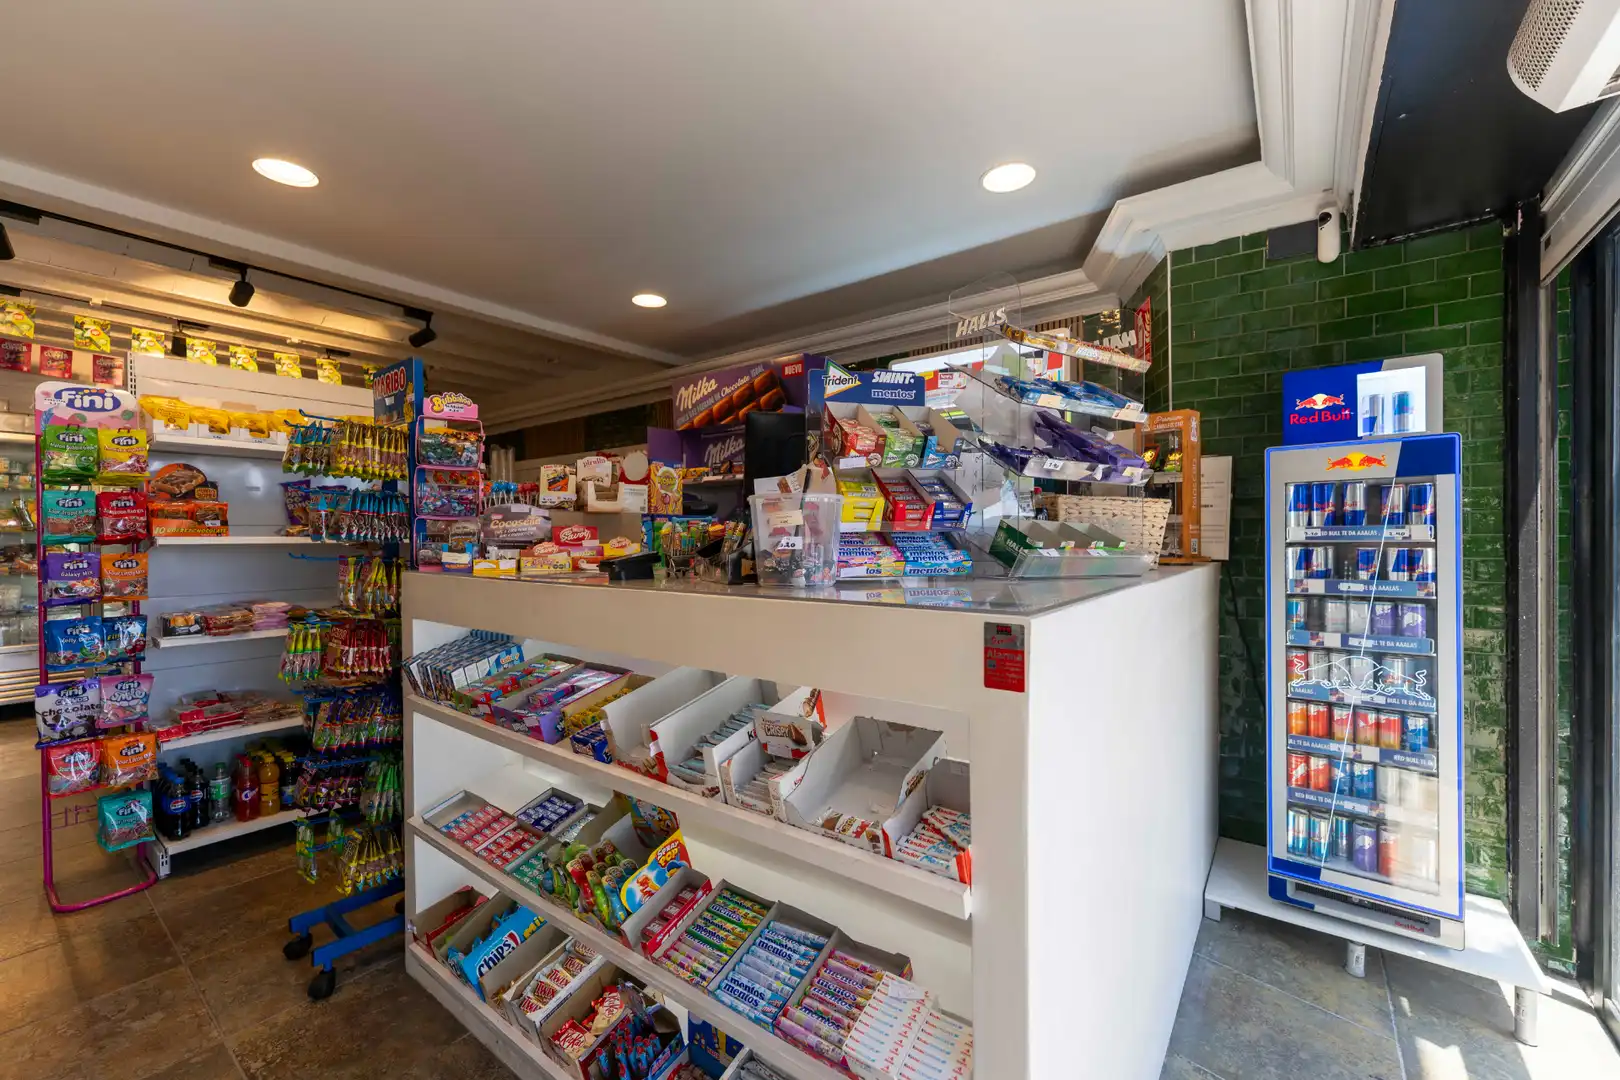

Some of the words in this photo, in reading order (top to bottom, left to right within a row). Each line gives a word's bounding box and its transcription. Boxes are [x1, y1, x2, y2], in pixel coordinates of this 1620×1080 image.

[955, 306, 1008, 338] HALLS
[373, 366, 407, 398] HARIBO
[720, 375, 751, 397] Chocolate
[822, 373, 859, 387] Trident
[872, 370, 915, 385] SMINT
[61, 389, 114, 411] Fini
[675, 376, 719, 411] Milka
[871, 388, 916, 399] mentos
[1289, 411, 1319, 425] Red
[1321, 407, 1351, 422] Bull
[704, 436, 746, 467] Milka
[908, 566, 949, 575] mentos
[764, 724, 790, 738] CRISPY
[657, 840, 680, 860] SPRAY
[897, 847, 921, 859] Kinder
[904, 838, 929, 849] Kinder
[659, 848, 679, 867] POP
[711, 903, 743, 922] mentos
[757, 939, 794, 961] mentos
[730, 976, 766, 1001] mentos
[824, 967, 865, 990] mentos
[723, 982, 760, 1008] mentos
[816, 978, 857, 1002] mentos
[800, 1004, 841, 1031] mentos
